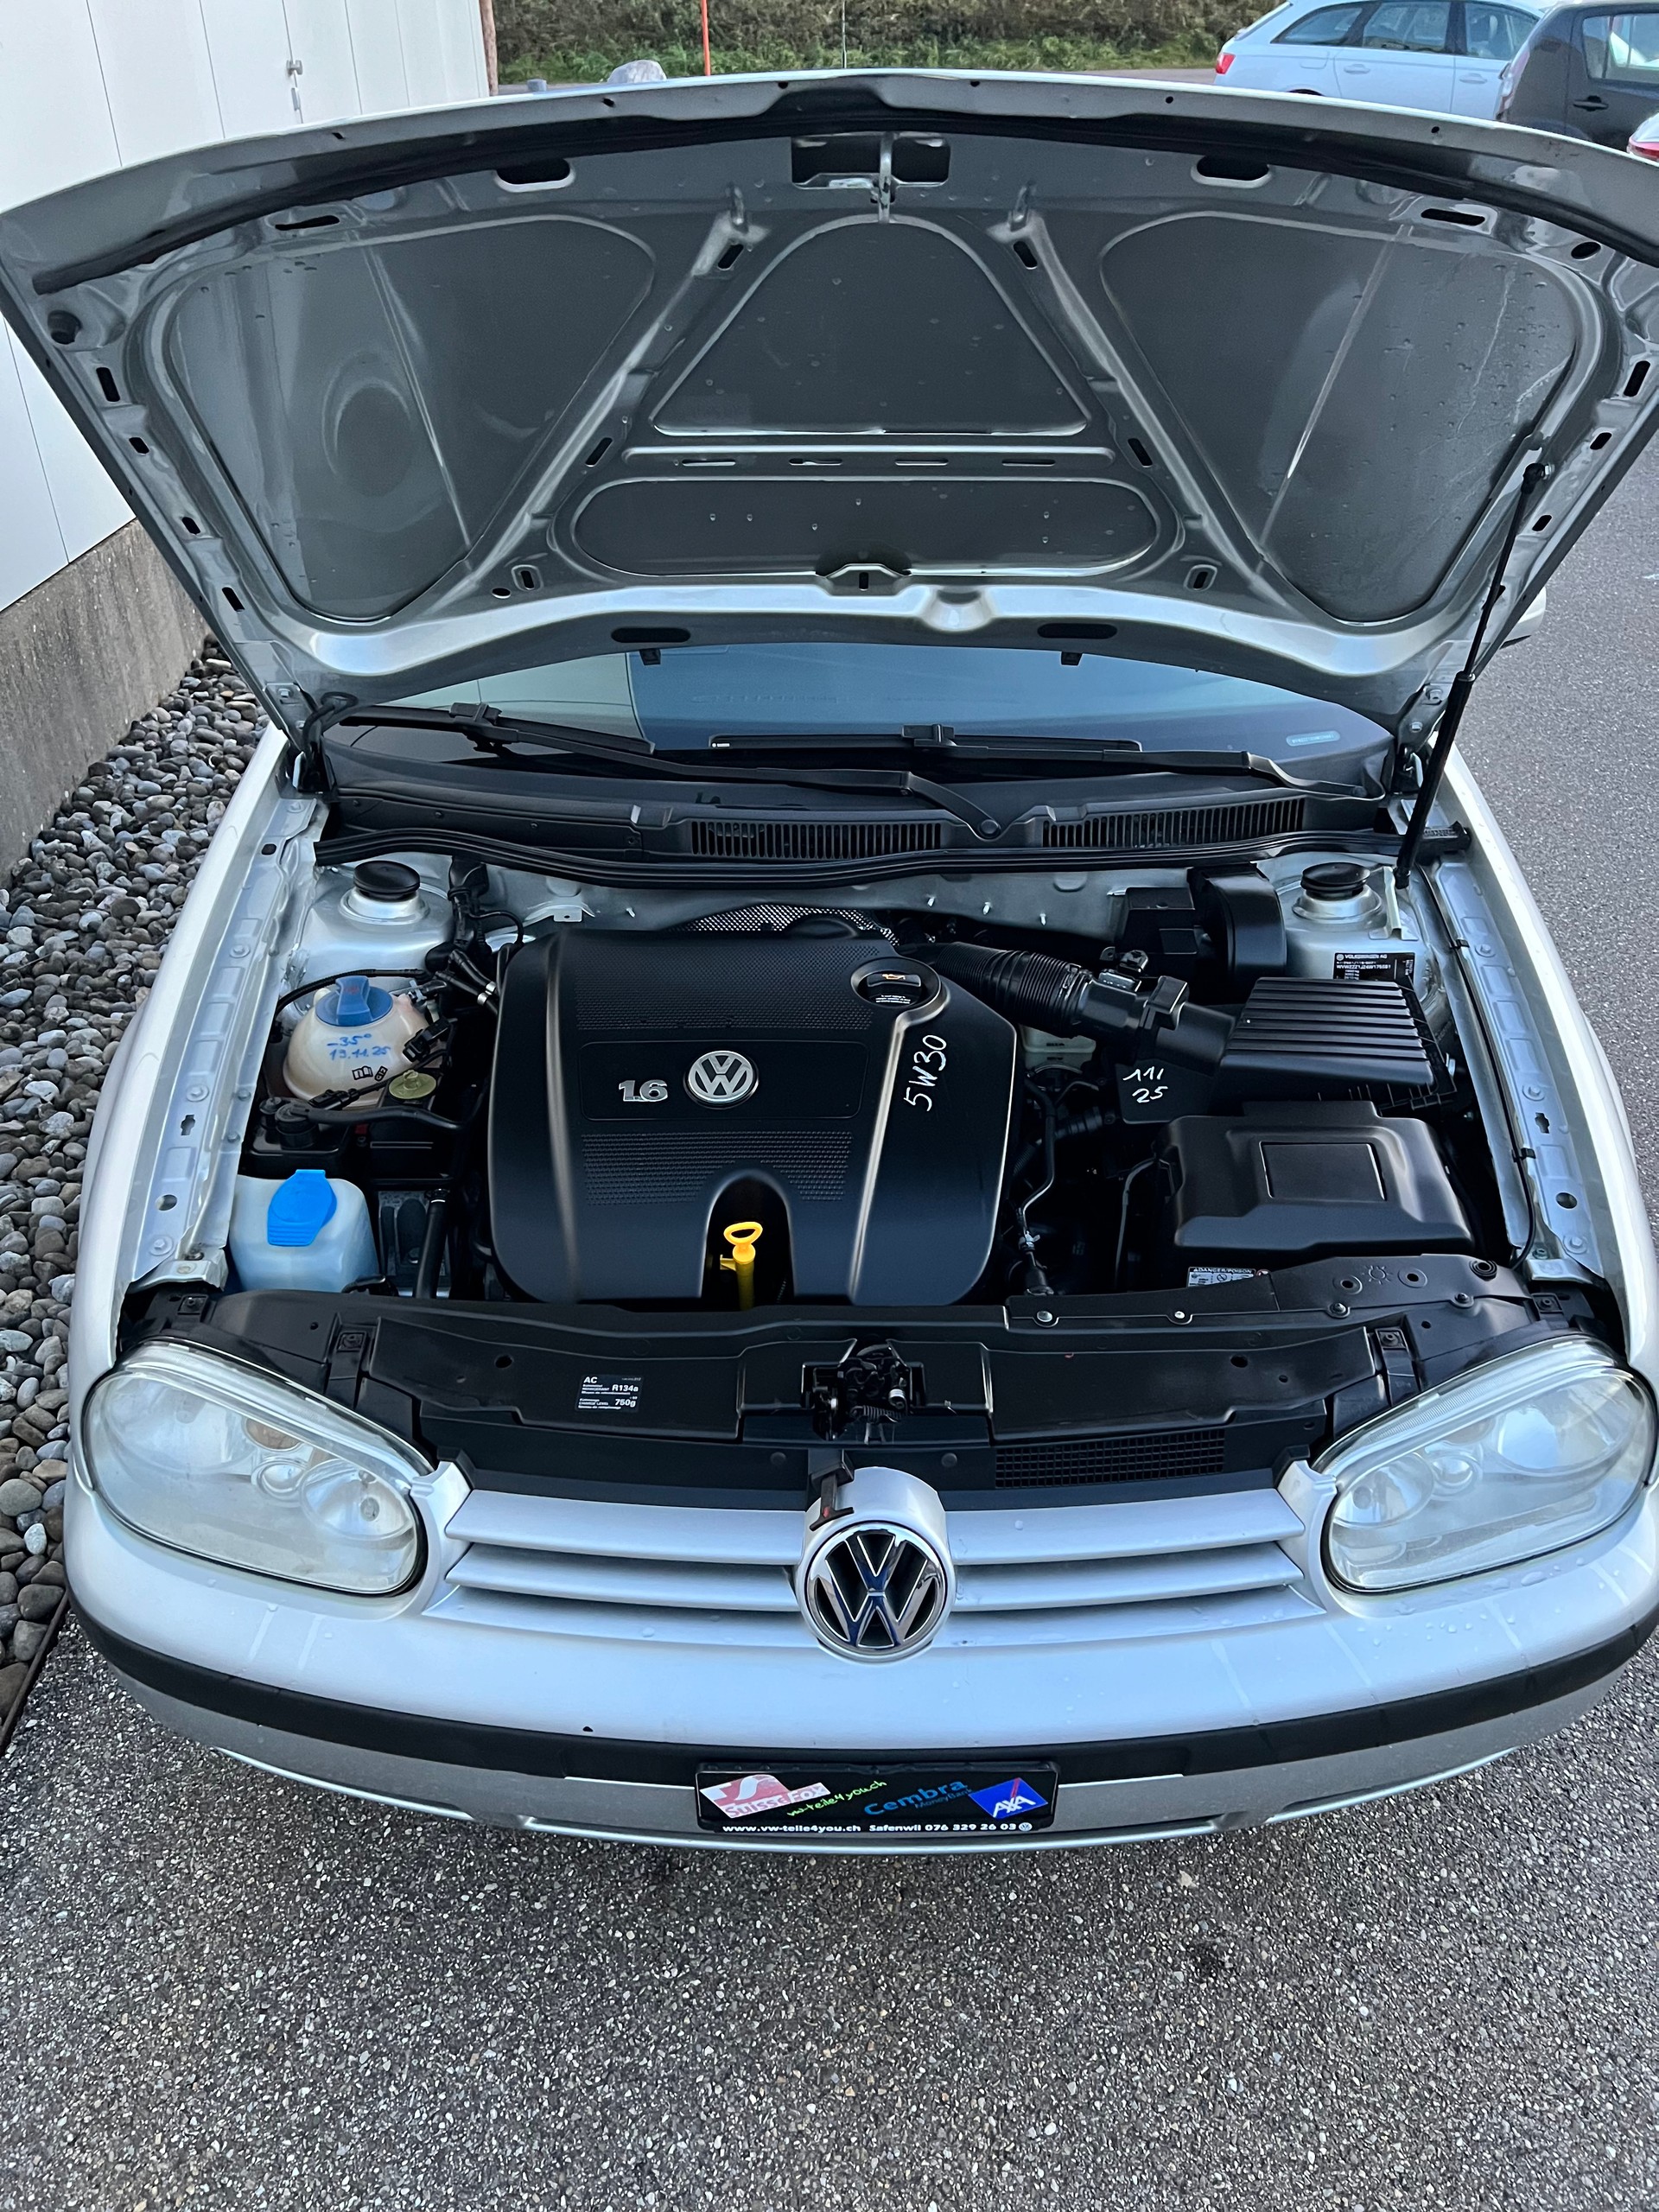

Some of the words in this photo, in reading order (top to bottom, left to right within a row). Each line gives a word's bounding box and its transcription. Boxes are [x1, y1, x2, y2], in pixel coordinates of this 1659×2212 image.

[329, 1046, 391, 1060] 19.11.25
[689, 1050, 753, 1103] VW
[903, 1034, 947, 1112] 5W30
[1132, 1085, 1168, 1103] 25
[615, 1399, 636, 1408] 750g
[807, 1524, 945, 1659] VW
[864, 1782, 968, 1815] Cembra
[993, 1796, 1036, 1818] AXA
[722, 1824, 861, 1834] www.vw-teile4you.ch
